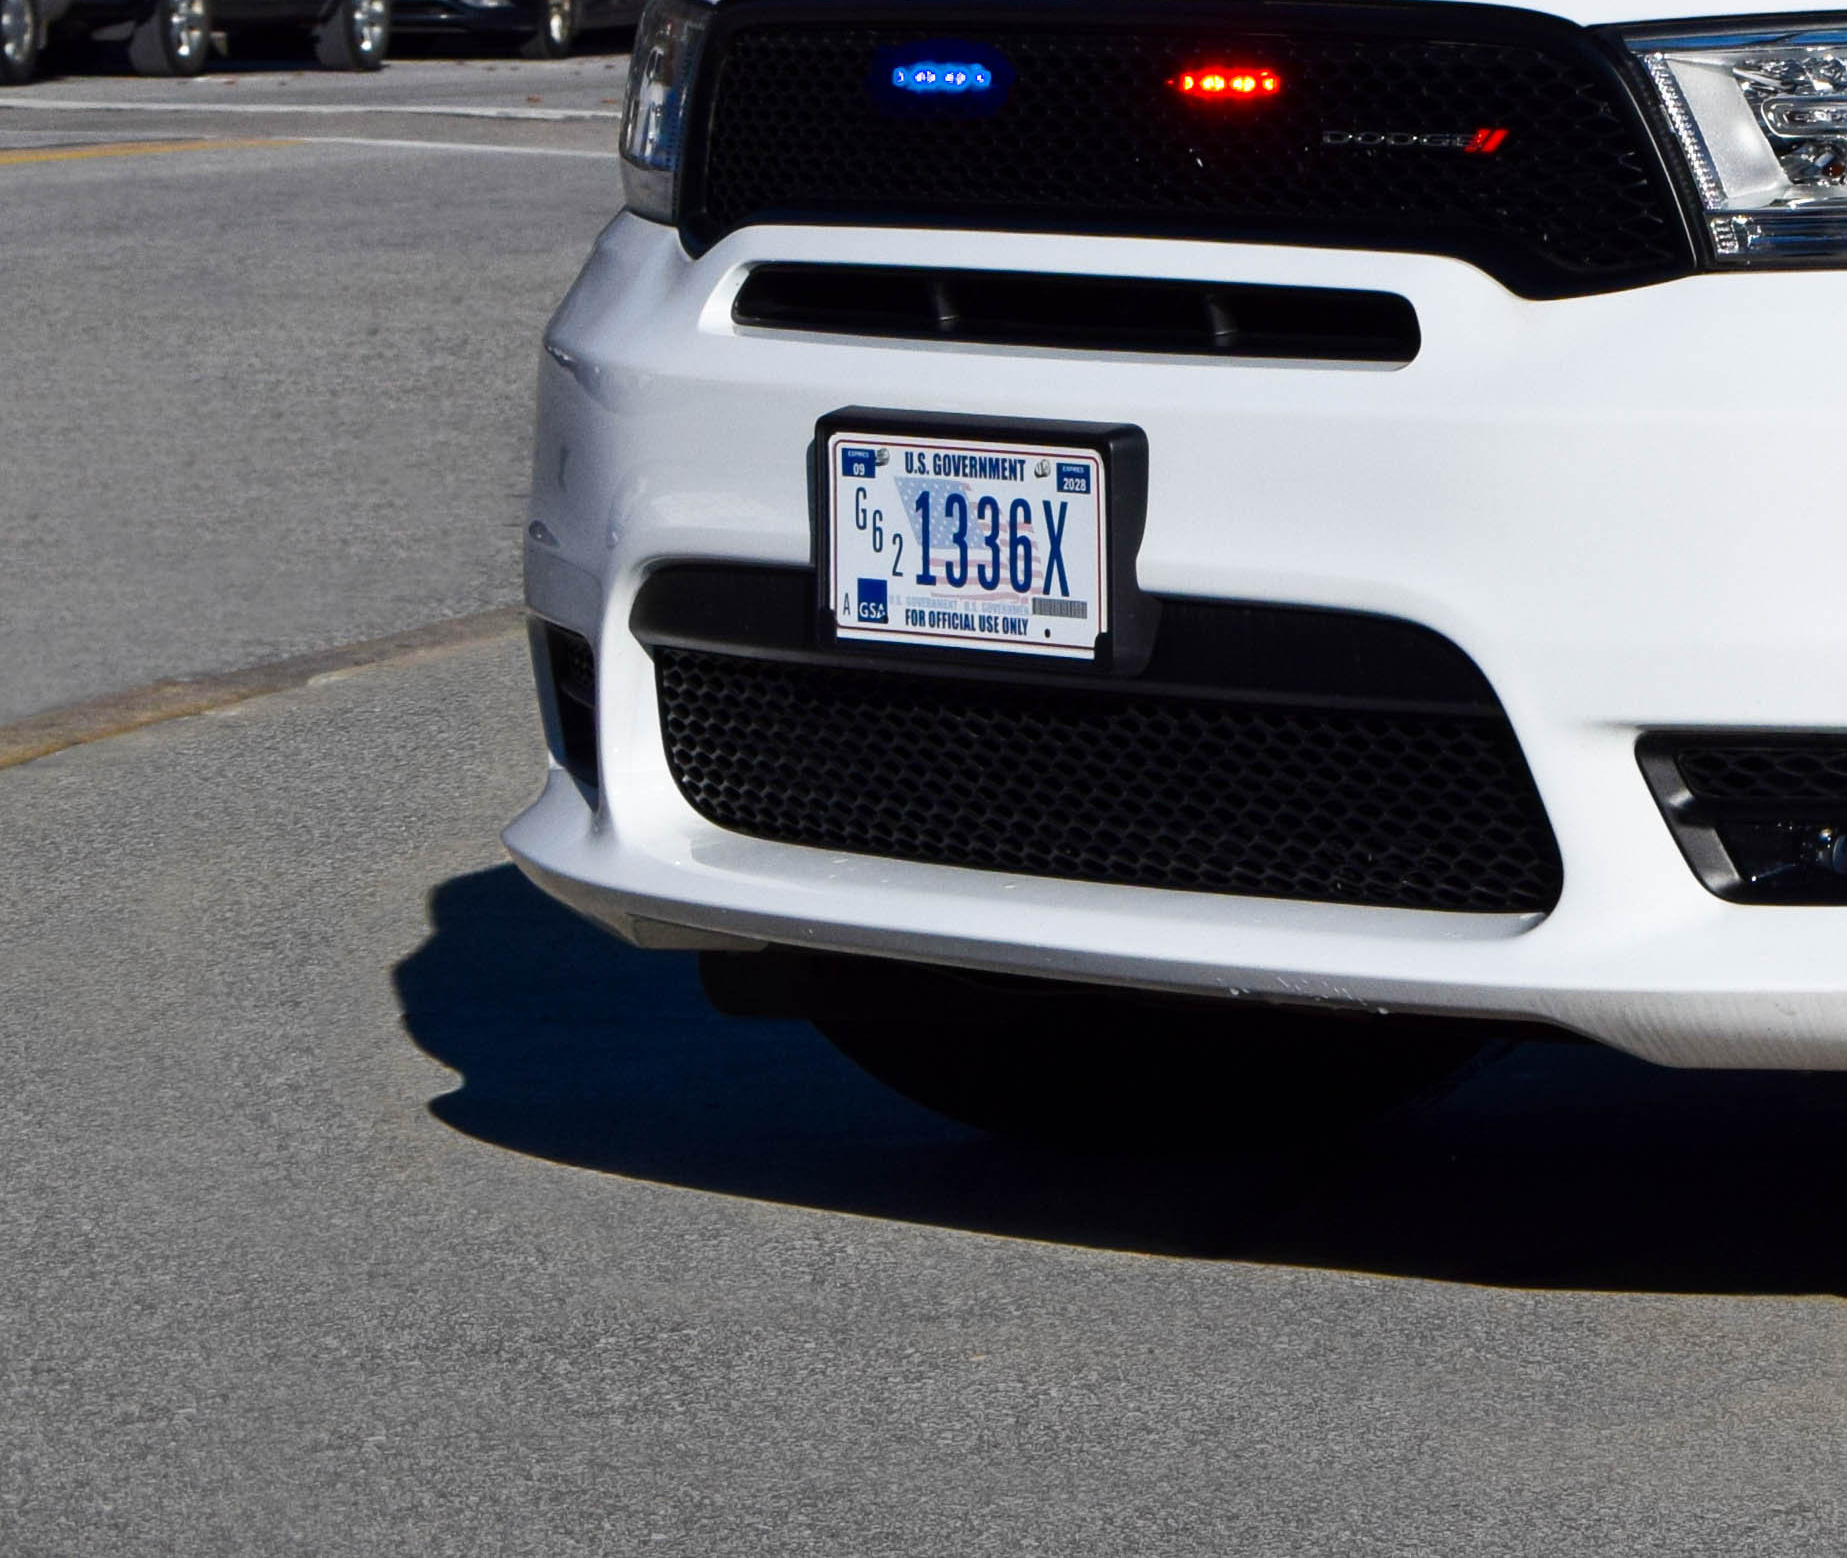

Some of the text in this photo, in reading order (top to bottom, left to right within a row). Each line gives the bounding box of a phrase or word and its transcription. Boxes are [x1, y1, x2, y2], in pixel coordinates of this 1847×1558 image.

[852, 463, 866, 476] 09
[904, 451, 1026, 481] U.S. GOVERNMENT
[1063, 476, 1087, 491] 2028
[914, 489, 1070, 597] 1336X
[843, 592, 851, 616] A
[858, 601, 887, 621] GSA
[905, 608, 1029, 636] FOR OFFICIAL USE ONLY
